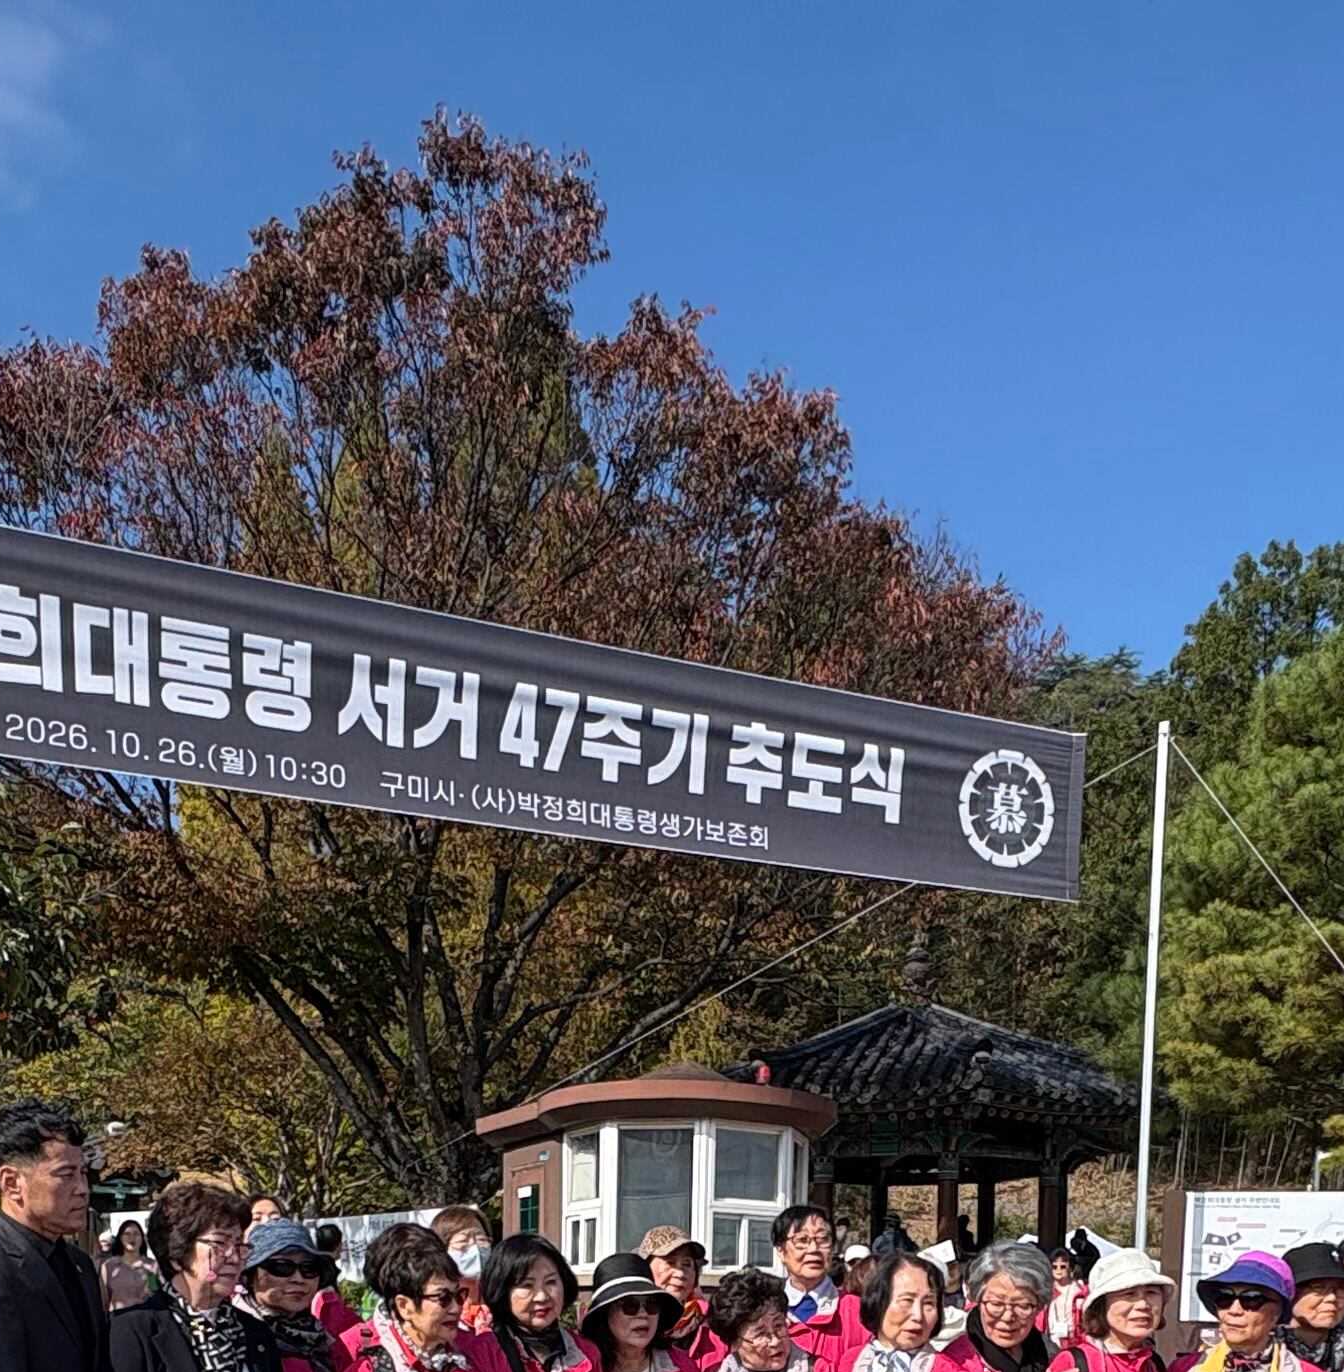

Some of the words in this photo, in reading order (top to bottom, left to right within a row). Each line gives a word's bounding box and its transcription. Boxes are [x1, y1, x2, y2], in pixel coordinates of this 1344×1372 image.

[4, 713, 98, 753] 2026.
[337, 656, 479, 760] 서거
[499, 683, 710, 795] 47주기
[726, 721, 905, 824] 추도식
[984, 783, 1030, 834] 慕
